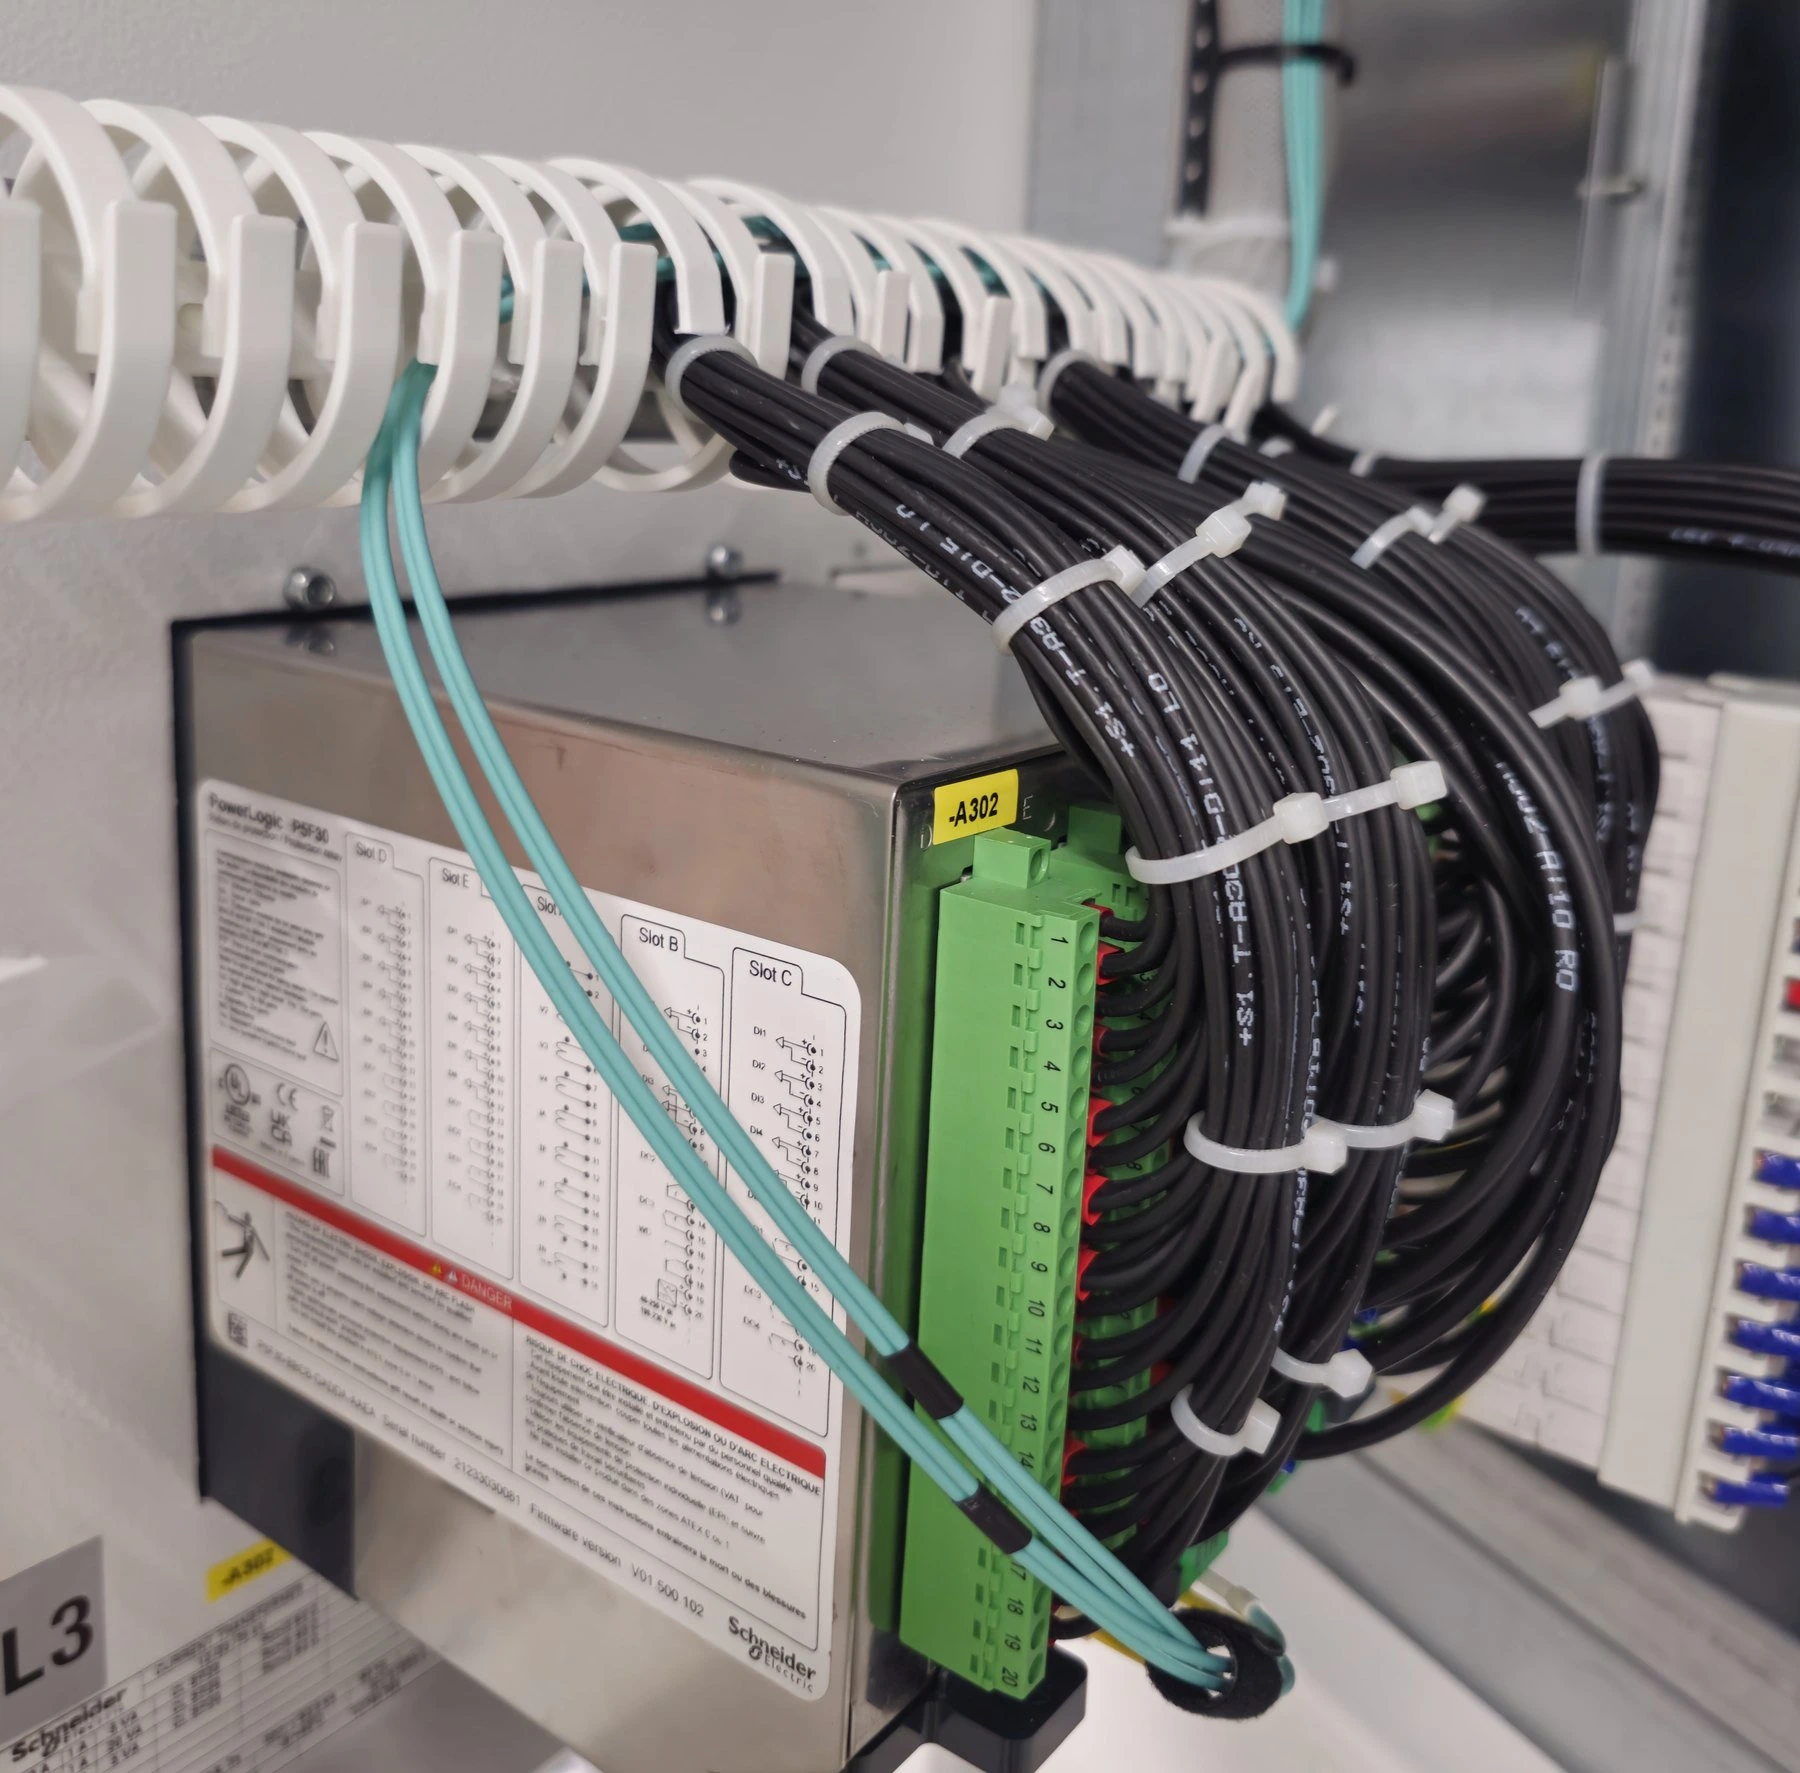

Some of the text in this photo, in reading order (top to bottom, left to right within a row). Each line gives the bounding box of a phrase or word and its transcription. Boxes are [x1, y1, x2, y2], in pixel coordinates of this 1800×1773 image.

[210, 792, 329, 845] PowerLogic P5F30
[949, 792, 999, 827] -A302
[442, 867, 470, 888] Slot E
[537, 896, 557, 915] Slot
[639, 927, 679, 952] Slot B
[1051, 936, 1069, 945] 1
[749, 960, 792, 987] Slot C
[1048, 976, 1066, 989] 2
[1045, 1019, 1064, 1031] 3
[1043, 1060, 1061, 1073] 4
[1041, 1102, 1059, 1114] 5
[1038, 1142, 1056, 1154] 6
[1035, 1183, 1054, 1195] 7
[1033, 1222, 1051, 1234] 8
[1031, 1261, 1048, 1274] 9
[461, 1274, 513, 1312] DANGER
[1028, 1299, 1045, 1317] 10
[1025, 1337, 1043, 1356] 11
[1022, 1375, 1040, 1395] 12
[1020, 1413, 1038, 1432] 13
[760, 1456, 821, 1496] ELECTRIQUE
[530, 1503, 579, 1542] Firmware
[582, 1537, 622, 1567] version
[1007, 1597, 1024, 1616] 18
[2, 1595, 94, 1696] L3
[728, 1615, 817, 1681] Schneider
[1004, 1632, 1021, 1652] 19
[764, 1654, 815, 1693] Electric
[1001, 1666, 1019, 1687] 20
[12, 1687, 127, 1763] Schneider
